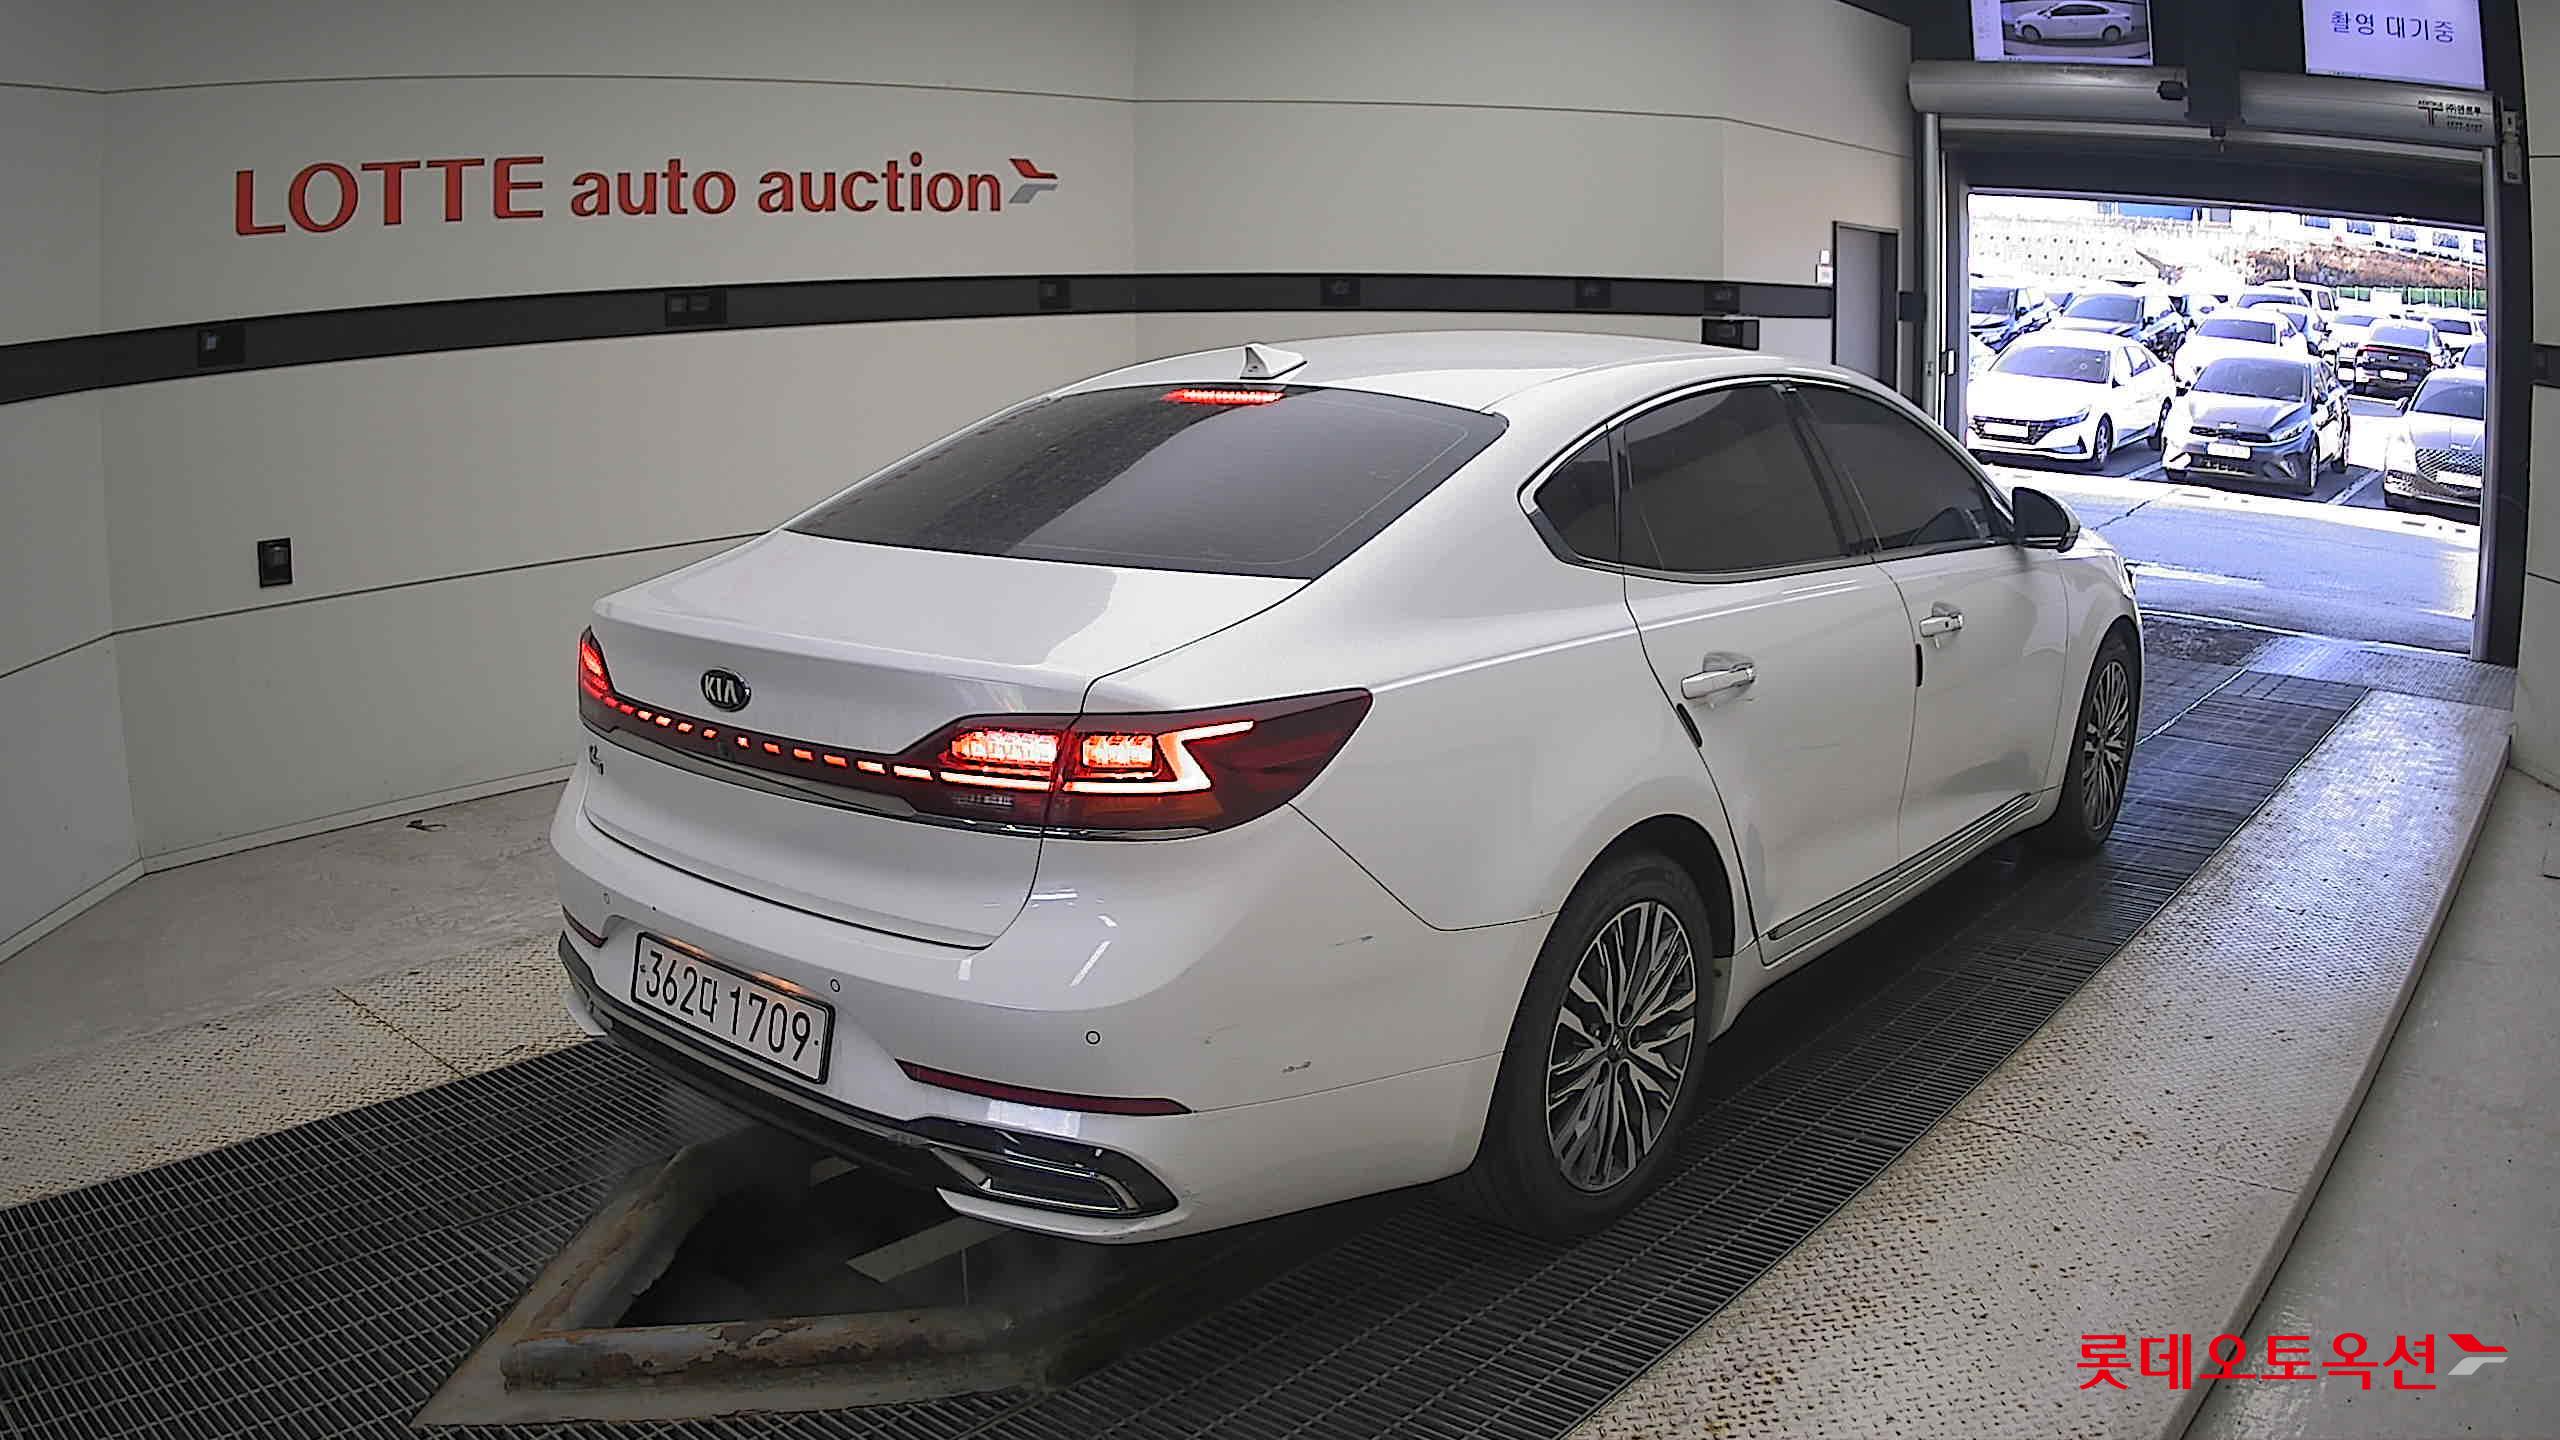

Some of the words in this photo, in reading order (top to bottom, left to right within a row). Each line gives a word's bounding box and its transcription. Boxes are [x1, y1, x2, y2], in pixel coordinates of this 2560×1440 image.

[2331, 11, 2375, 36] 촬영
[2386, 16, 2455, 43] 대기중
[234, 155, 545, 236] LOTTE
[570, 159, 737, 217] auto
[756, 152, 1004, 214] auction
[705, 673, 739, 705] KIA
[646, 950, 718, 1023] 362다
[730, 986, 811, 1062] 1709
